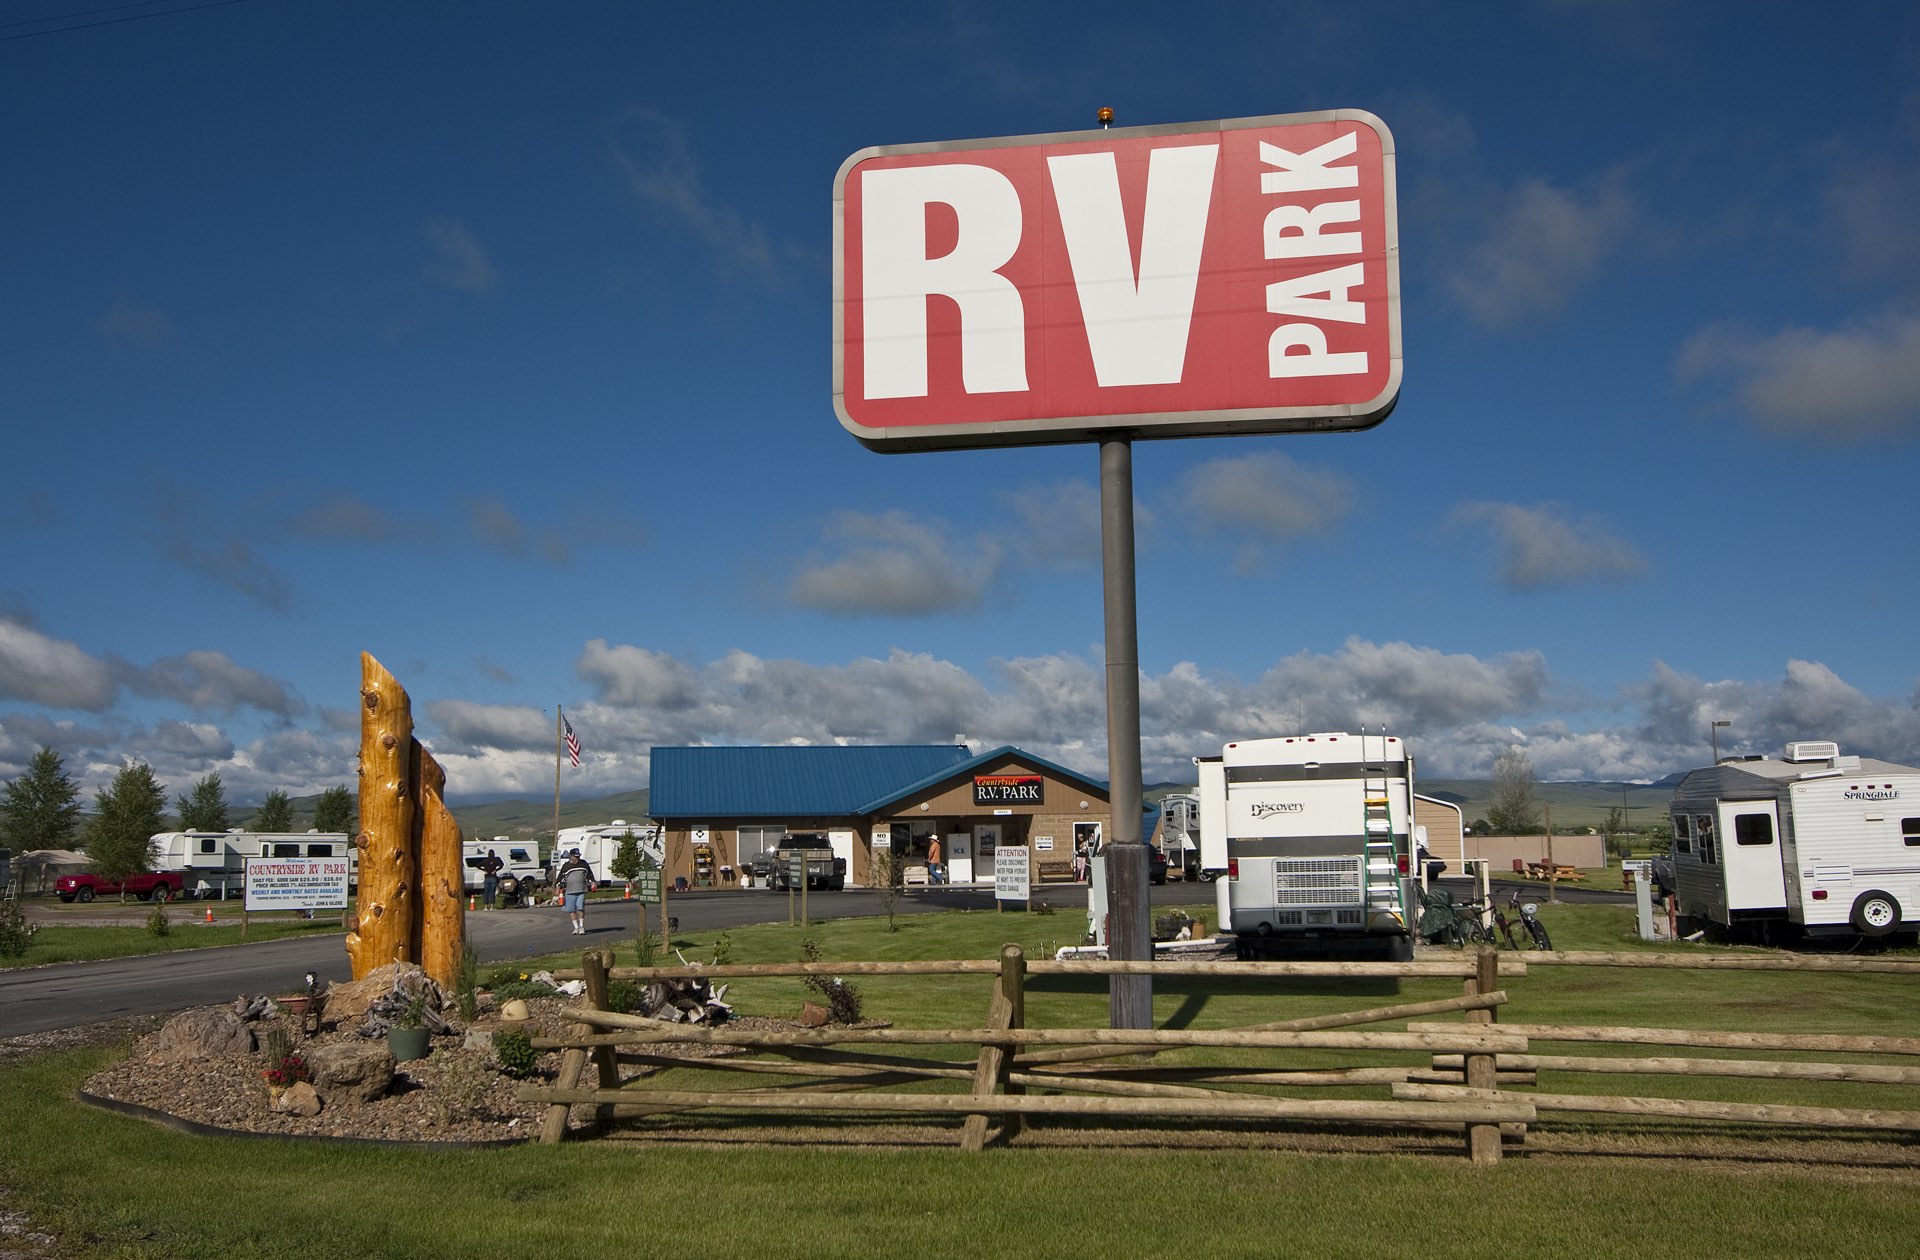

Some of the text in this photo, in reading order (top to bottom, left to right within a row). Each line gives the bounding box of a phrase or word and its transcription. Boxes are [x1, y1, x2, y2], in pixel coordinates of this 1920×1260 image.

[1259, 131, 1368, 378] PARK
[861, 144, 1219, 399] RV
[977, 778, 1018, 788] Countryside
[1002, 786, 1039, 798] PARK
[1844, 791, 1900, 800] SPRINGDALE
[1251, 802, 1305, 818] Discovery
[250, 864, 346, 875] COUNTRYSIDE RV PARK
